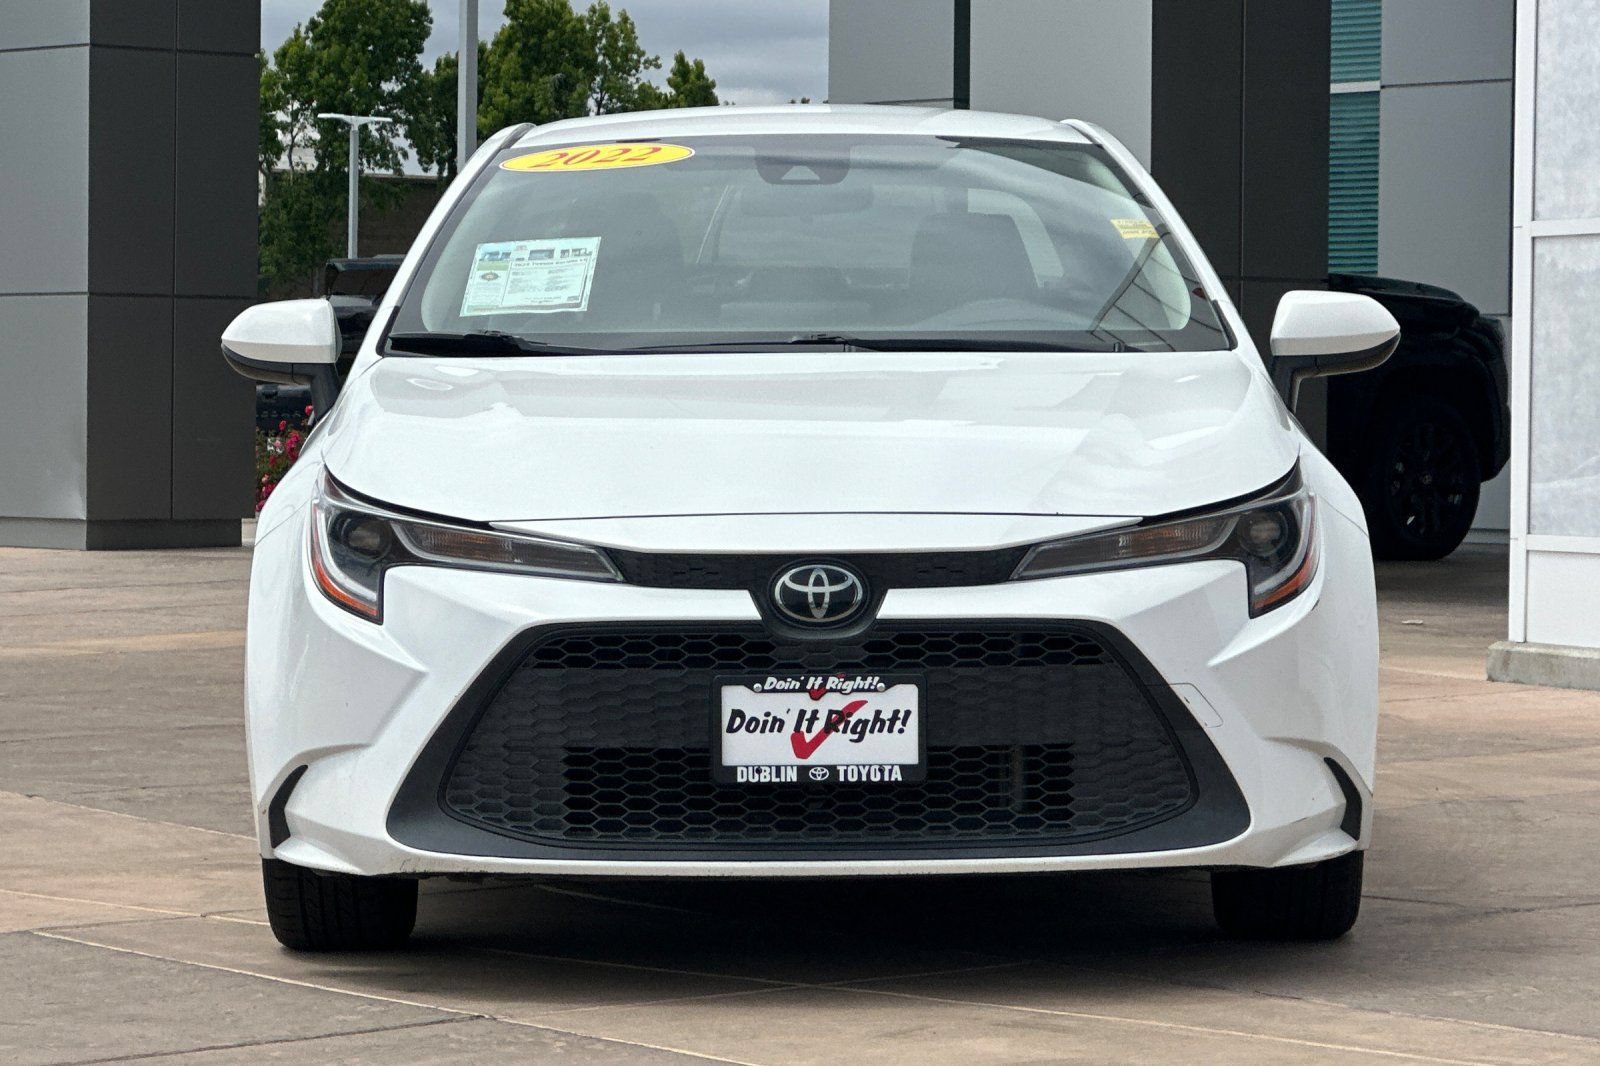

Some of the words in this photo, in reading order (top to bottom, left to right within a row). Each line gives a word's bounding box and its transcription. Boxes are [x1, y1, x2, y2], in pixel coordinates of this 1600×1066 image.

[528, 146, 662, 168] 2022
[764, 676, 804, 690] Doin'
[806, 676, 823, 690] It
[826, 676, 880, 694] Right!
[726, 708, 791, 734] Doin'
[793, 709, 819, 734] It
[823, 709, 912, 743] Right!
[736, 766, 797, 783] DUBLIN
[837, 765, 902, 782] TOYOTA
